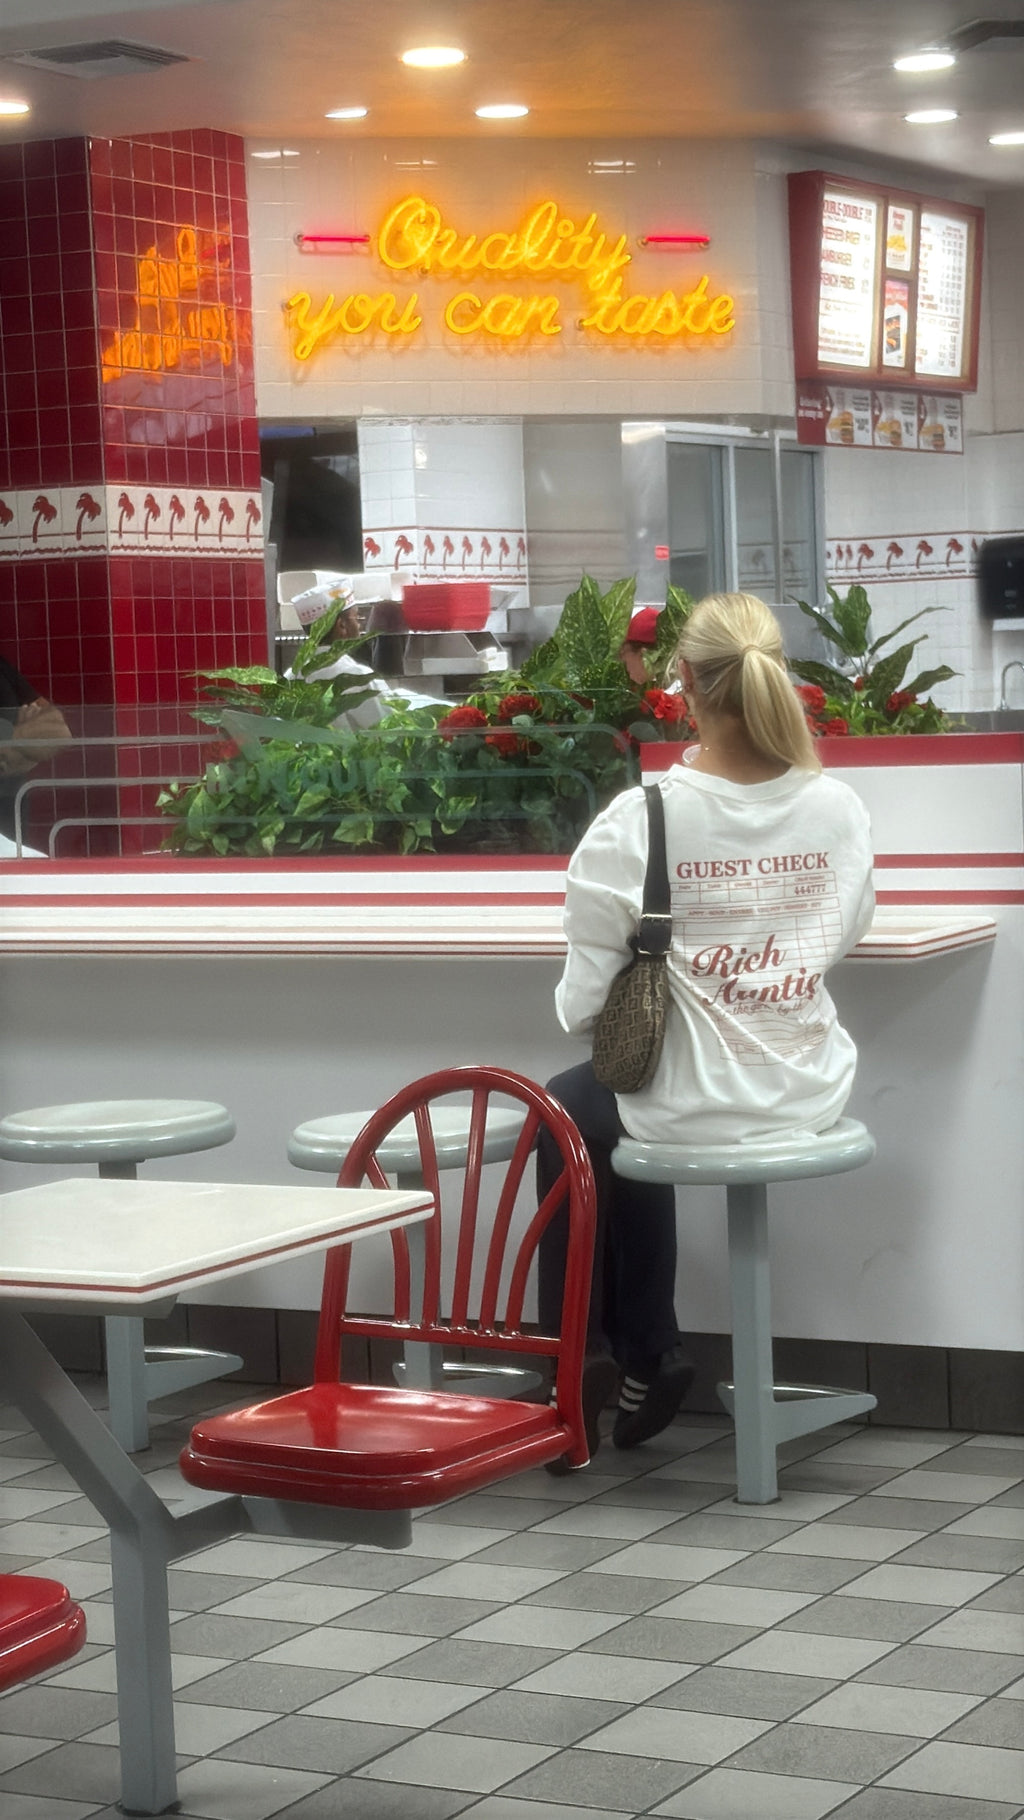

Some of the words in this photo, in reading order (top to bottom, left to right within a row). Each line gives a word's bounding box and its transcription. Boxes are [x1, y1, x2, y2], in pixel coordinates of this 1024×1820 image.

[378, 196, 632, 289] Quality
[288, 291, 422, 360] you
[445, 291, 562, 336] can
[582, 275, 736, 336] taste
[676, 859, 752, 880] GUEST
[757, 851, 830, 875] CHECK
[691, 934, 787, 979] Rich
[702, 967, 822, 1006] Auntie
